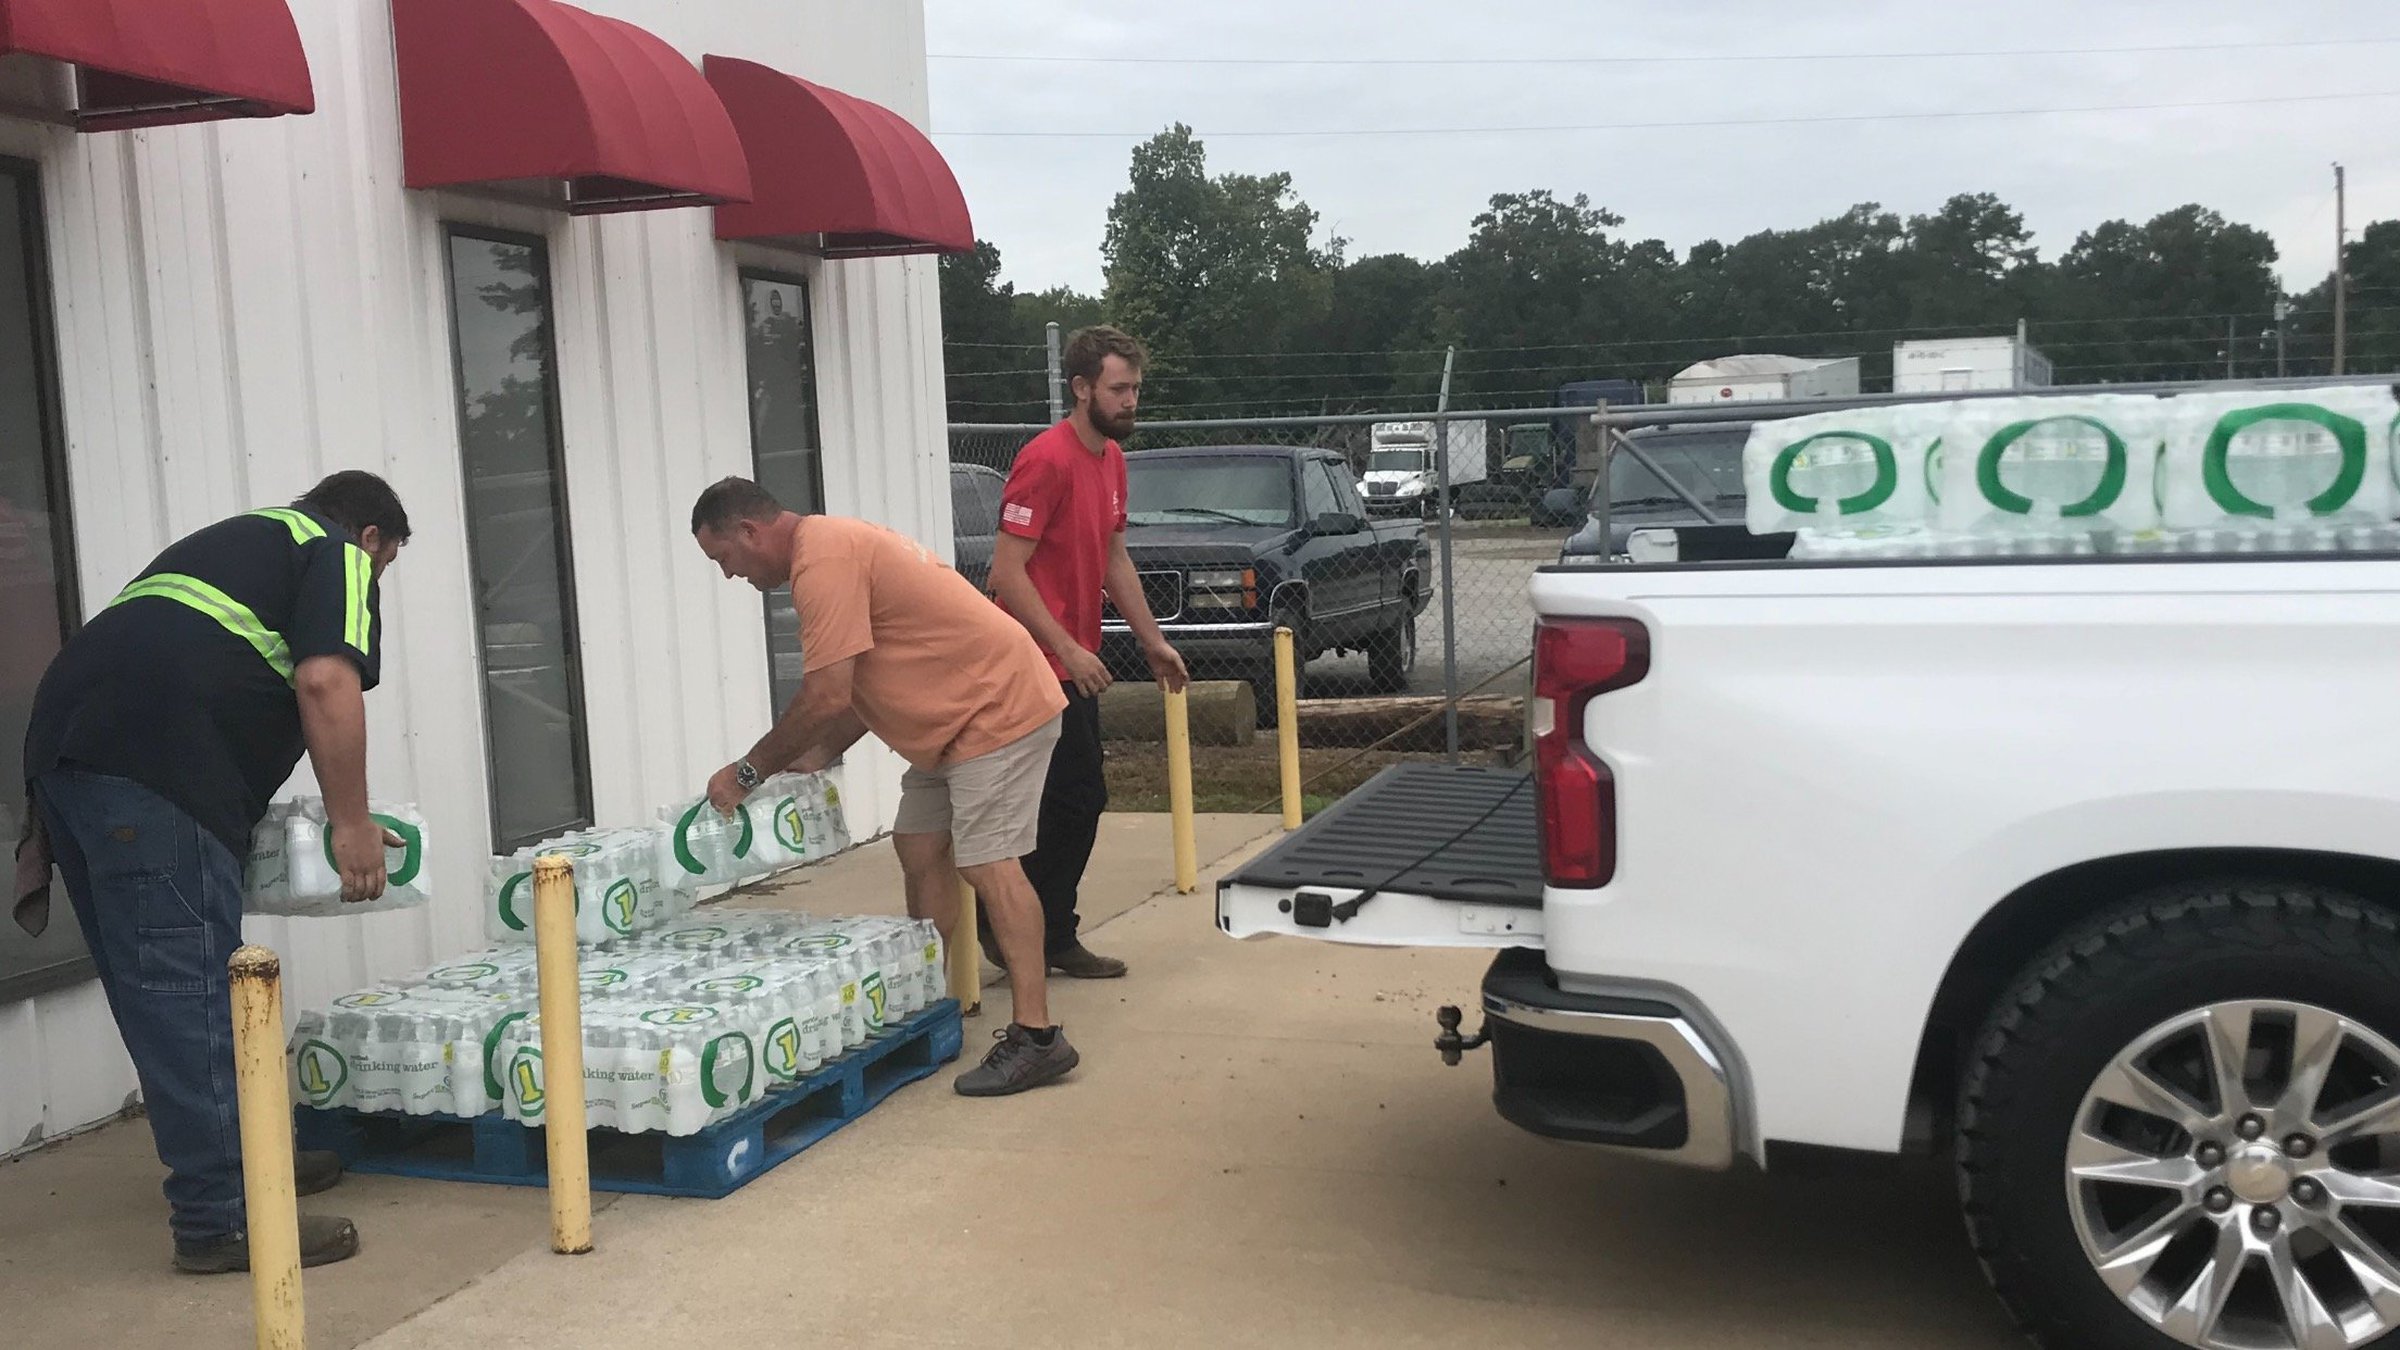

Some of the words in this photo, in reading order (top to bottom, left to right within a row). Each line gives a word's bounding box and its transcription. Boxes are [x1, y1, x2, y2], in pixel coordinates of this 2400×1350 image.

[614, 887, 633, 928] 1
[775, 1028, 798, 1072] 1
[517, 1059, 544, 1105] 1
[617, 1069, 655, 1081] water
